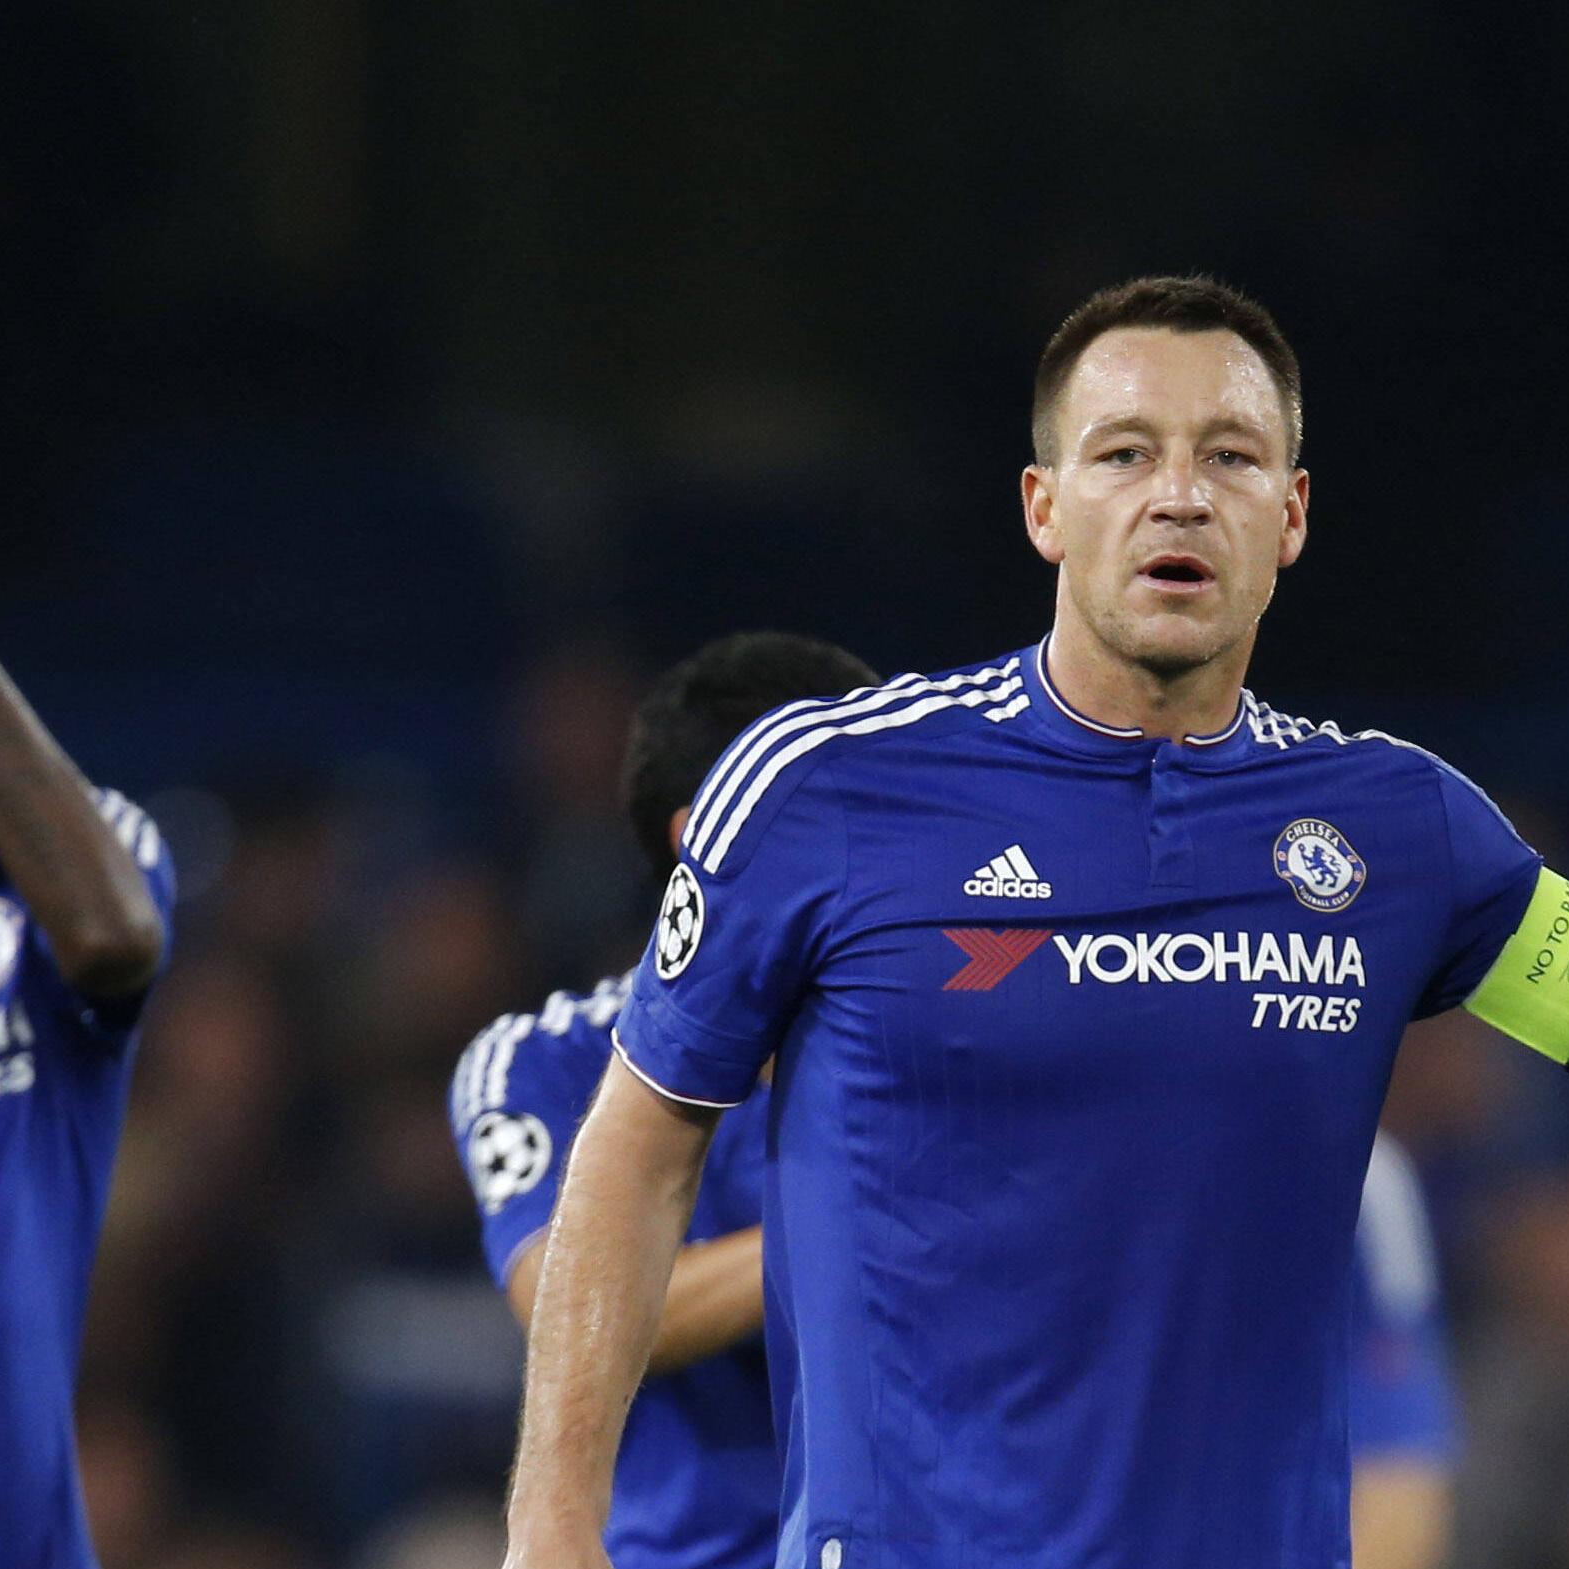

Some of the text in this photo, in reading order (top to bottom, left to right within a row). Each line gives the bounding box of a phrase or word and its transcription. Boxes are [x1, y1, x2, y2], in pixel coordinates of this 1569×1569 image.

[1286, 822, 1341, 848] CHELSEA
[963, 876, 1052, 899] adidas
[1052, 932, 1366, 986] YOKOHAMA
[1526, 948, 1554, 984] NO
[1546, 916, 1569, 944] TO
[1251, 992, 1362, 1032] TYRES
